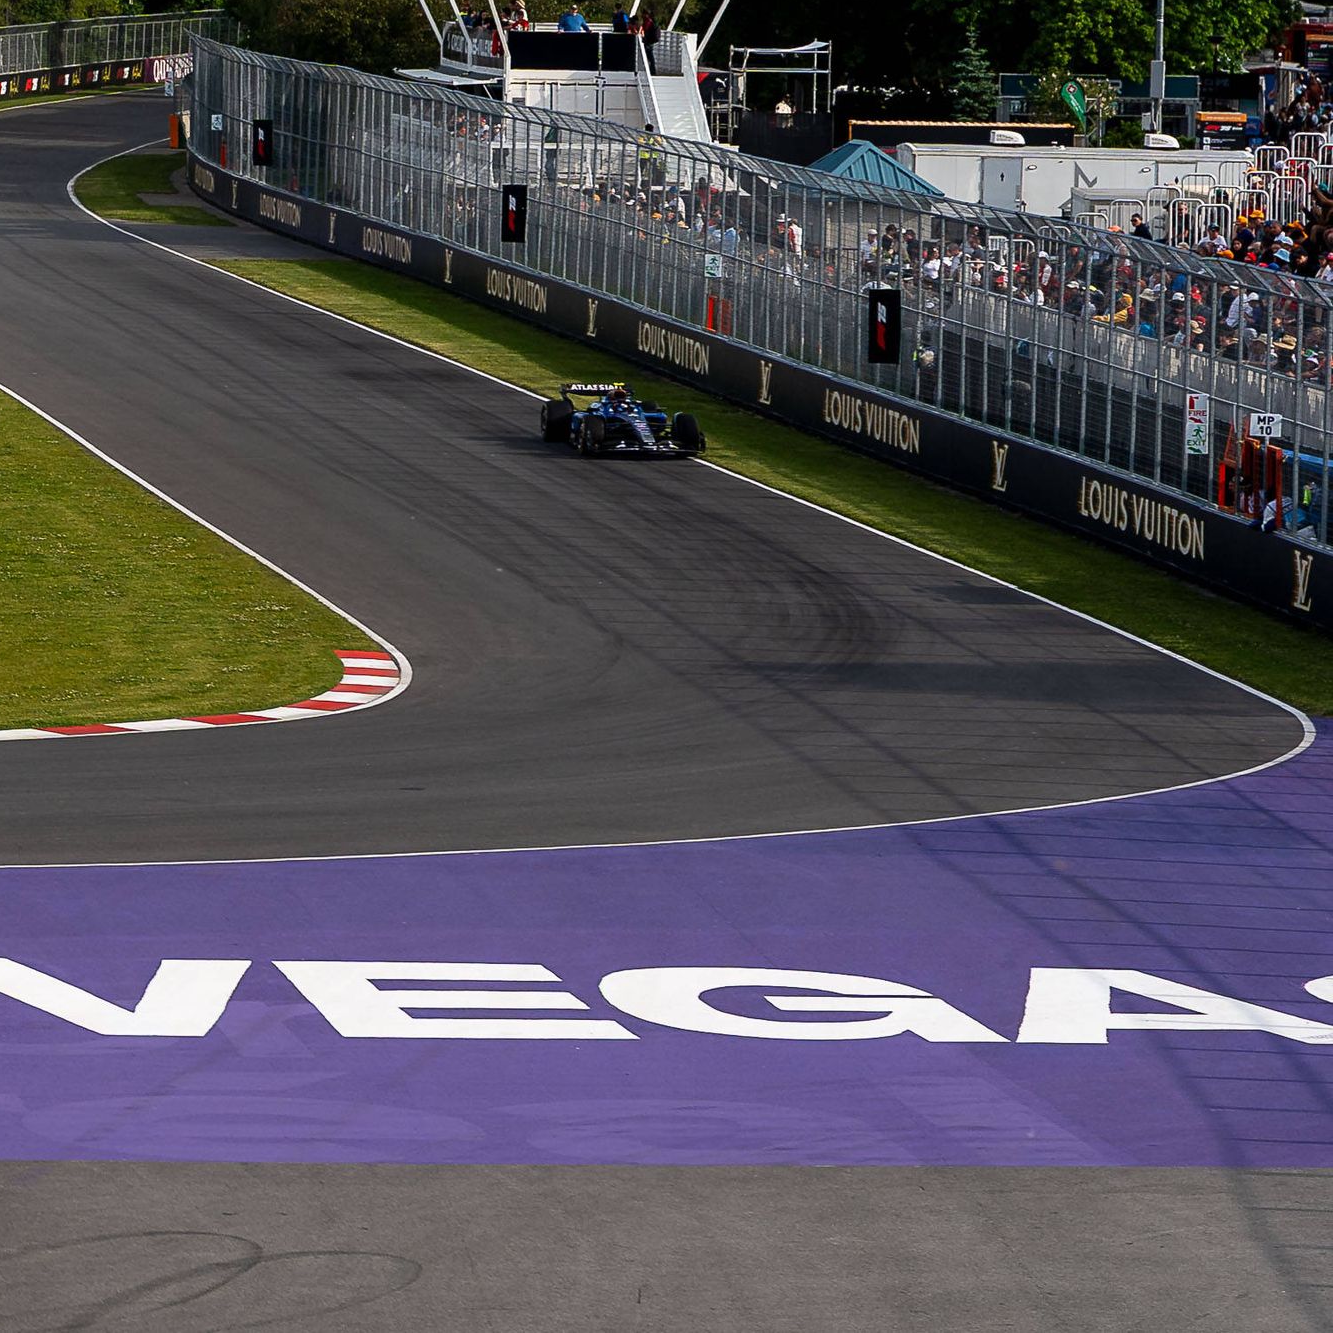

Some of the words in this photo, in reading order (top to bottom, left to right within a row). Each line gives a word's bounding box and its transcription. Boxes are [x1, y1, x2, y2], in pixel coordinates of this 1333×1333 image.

[363, 226, 382, 256] LOUIS
[383, 232, 412, 264] VUITTON
[487, 267, 511, 301] LOUIS
[512, 274, 547, 313] VUITTON
[638, 320, 666, 359] LOUIS
[667, 332, 709, 375] VUITTON
[824, 388, 861, 434] LOUIS
[865, 401, 920, 454] VUITTON
[1257, 415, 1275, 425] MP
[1259, 425, 1272, 435] 10
[1079, 476, 1128, 532] LOUIS
[1132, 494, 1204, 561] VUITTON
